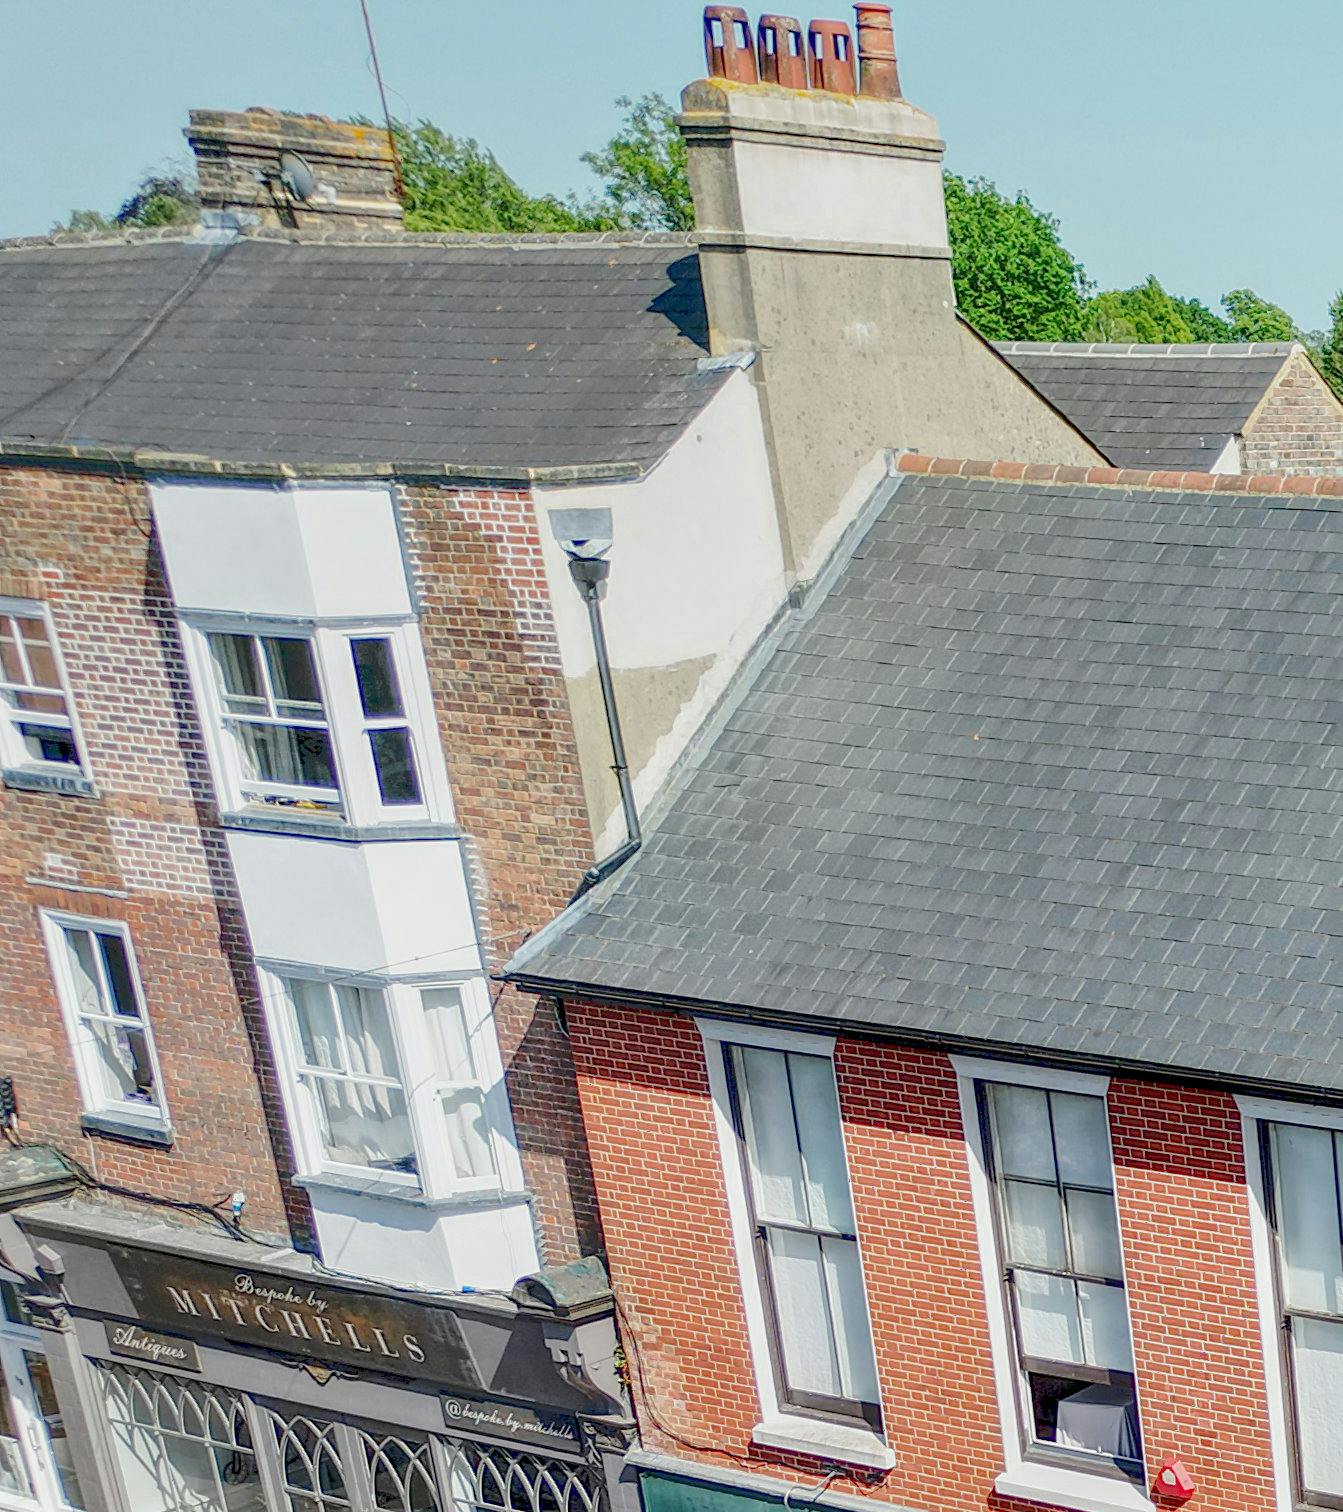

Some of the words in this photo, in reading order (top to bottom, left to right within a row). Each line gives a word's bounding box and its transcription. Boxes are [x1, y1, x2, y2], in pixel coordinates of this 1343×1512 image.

[234, 1273, 302, 1304] Bespoke
[302, 1290, 329, 1313] by
[112, 1326, 188, 1361] Antiques
[165, 1285, 427, 1364] MITCHELLS
